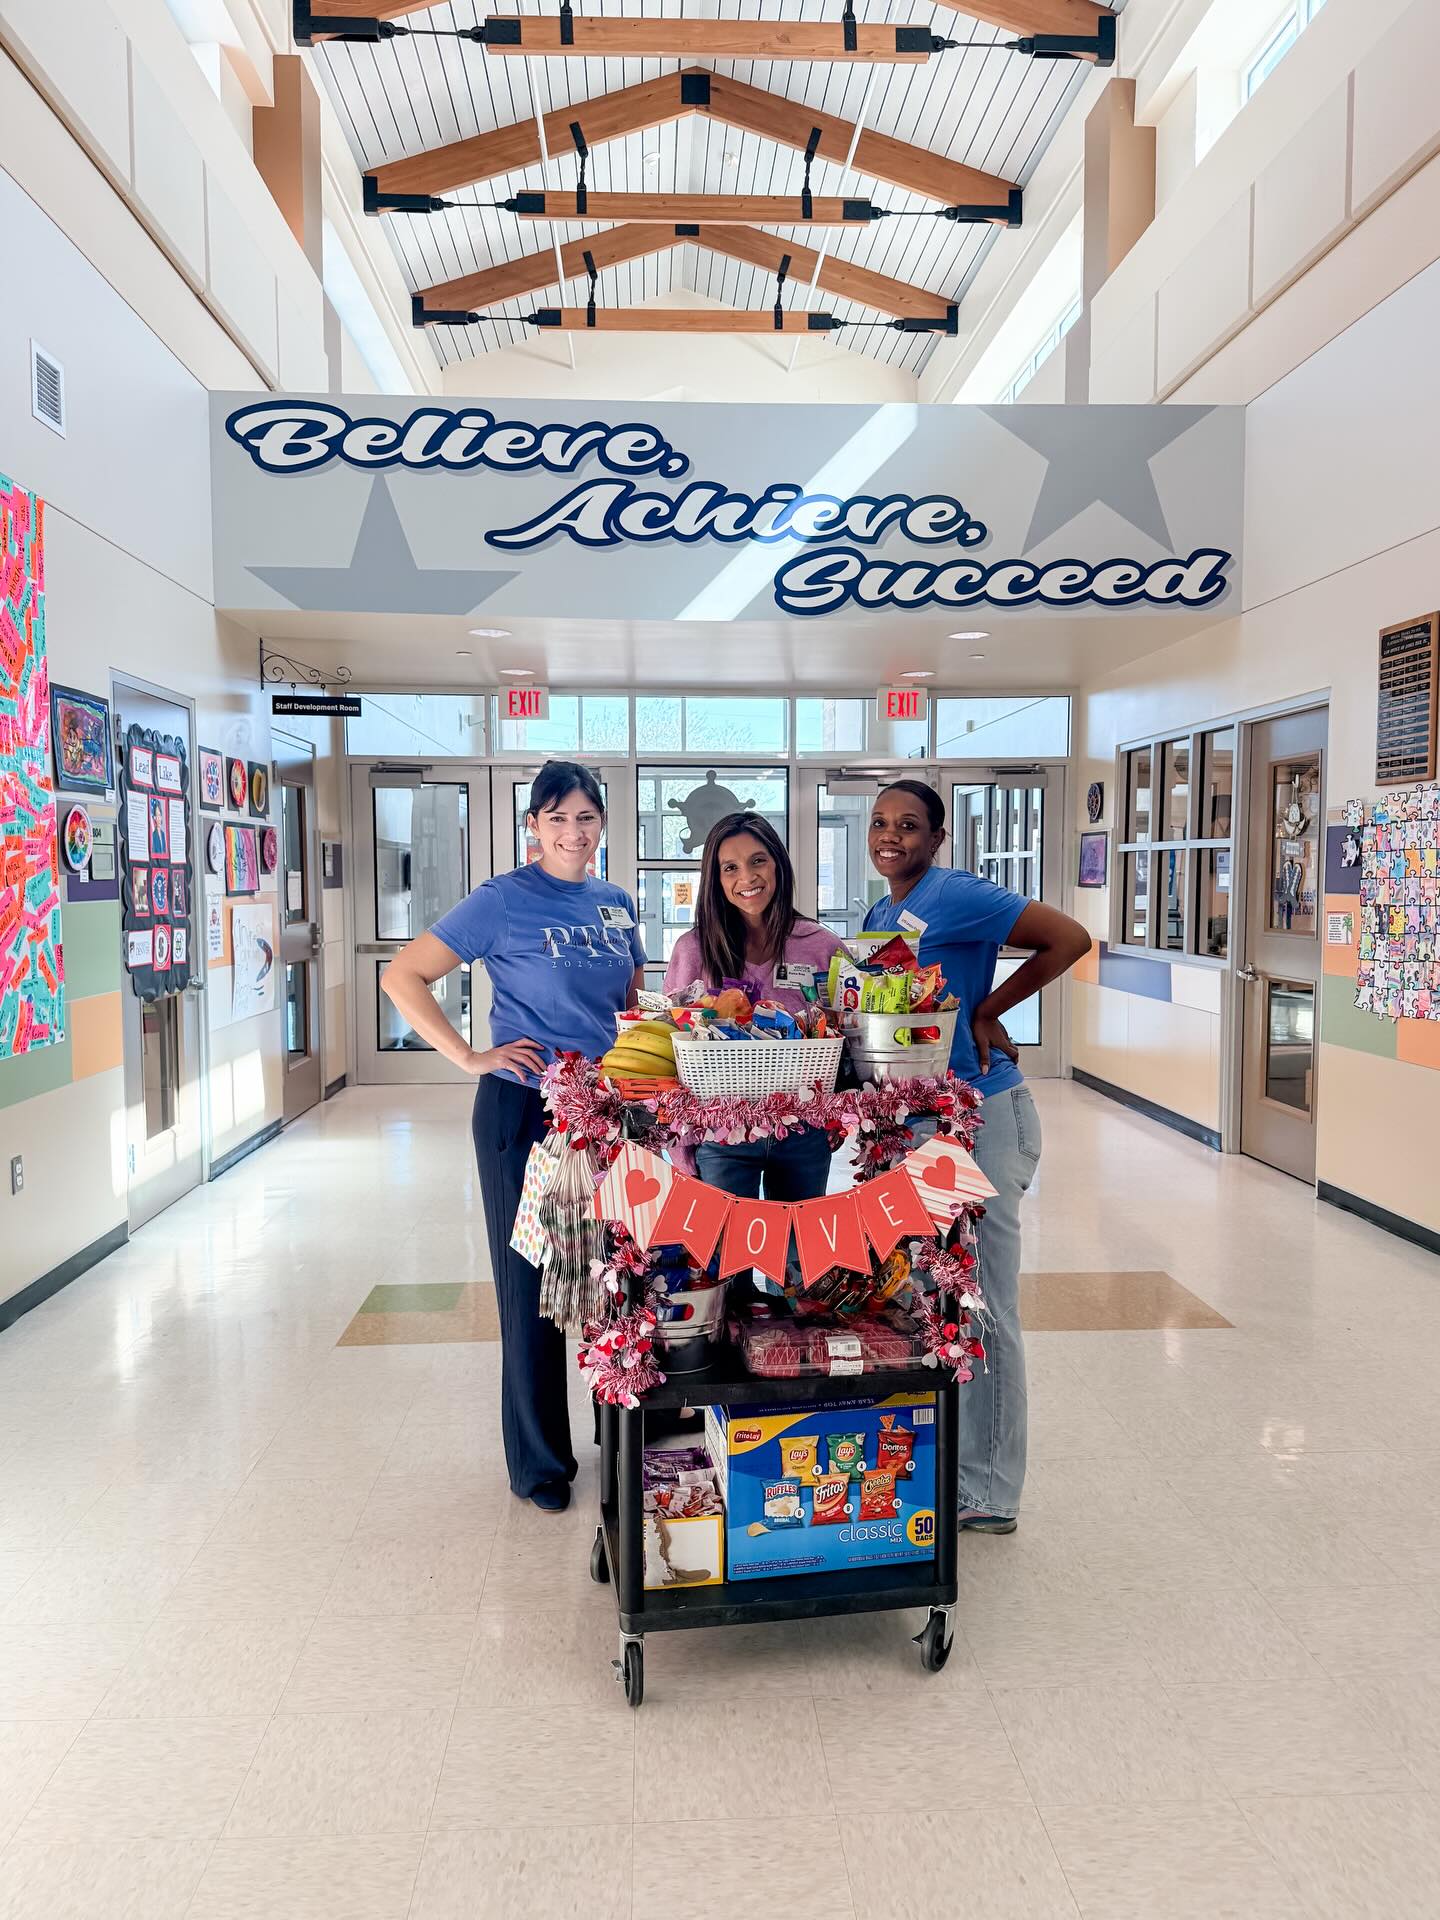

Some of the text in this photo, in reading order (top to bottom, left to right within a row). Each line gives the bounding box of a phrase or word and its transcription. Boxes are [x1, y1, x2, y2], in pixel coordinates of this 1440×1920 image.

[226, 400, 689, 478] Believe,
[484, 478, 987, 547] Achieve,
[774, 546, 1231, 616] Succeed
[275, 702, 360, 712] Staff Development Room
[508, 689, 542, 717] EXIT
[887, 691, 920, 718] EXIT
[683, 1192, 903, 1255] LOVE
[837, 1446, 855, 1457] Lay's
[882, 1443, 908, 1451] Doritos
[765, 1484, 797, 1500] RUFFLES
[816, 1481, 844, 1504] Fritos
[864, 1473, 892, 1495] Cheetos
[838, 1521, 903, 1543] classic
[914, 1515, 934, 1535] 50
